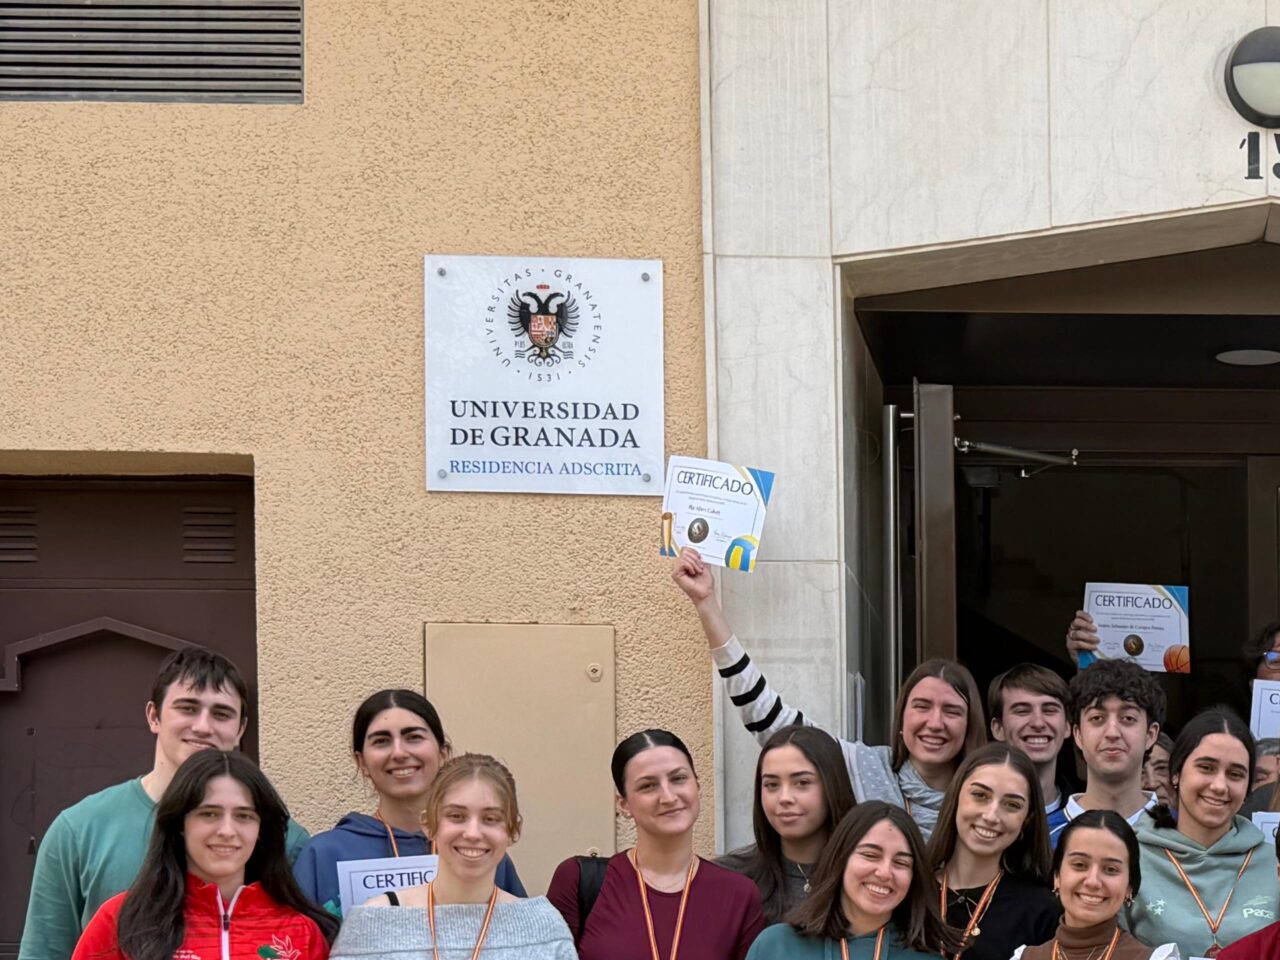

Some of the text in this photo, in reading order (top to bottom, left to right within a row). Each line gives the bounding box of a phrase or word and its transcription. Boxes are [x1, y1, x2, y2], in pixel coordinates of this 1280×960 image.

[486, 268, 532, 367] UNIVERSITAS
[554, 269, 602, 368] GRANATENSIS
[528, 372, 560, 382] 1531
[450, 400, 640, 421] UNIVERSIDAD
[450, 426, 640, 449] DE GRANADA
[450, 460, 642, 477] RESIDENCIA ADSCRITA
[677, 470, 754, 496] CERTIFICADO
[1095, 594, 1173, 609] CERTIFICADO
[362, 870, 434, 889] CERTIFIC
